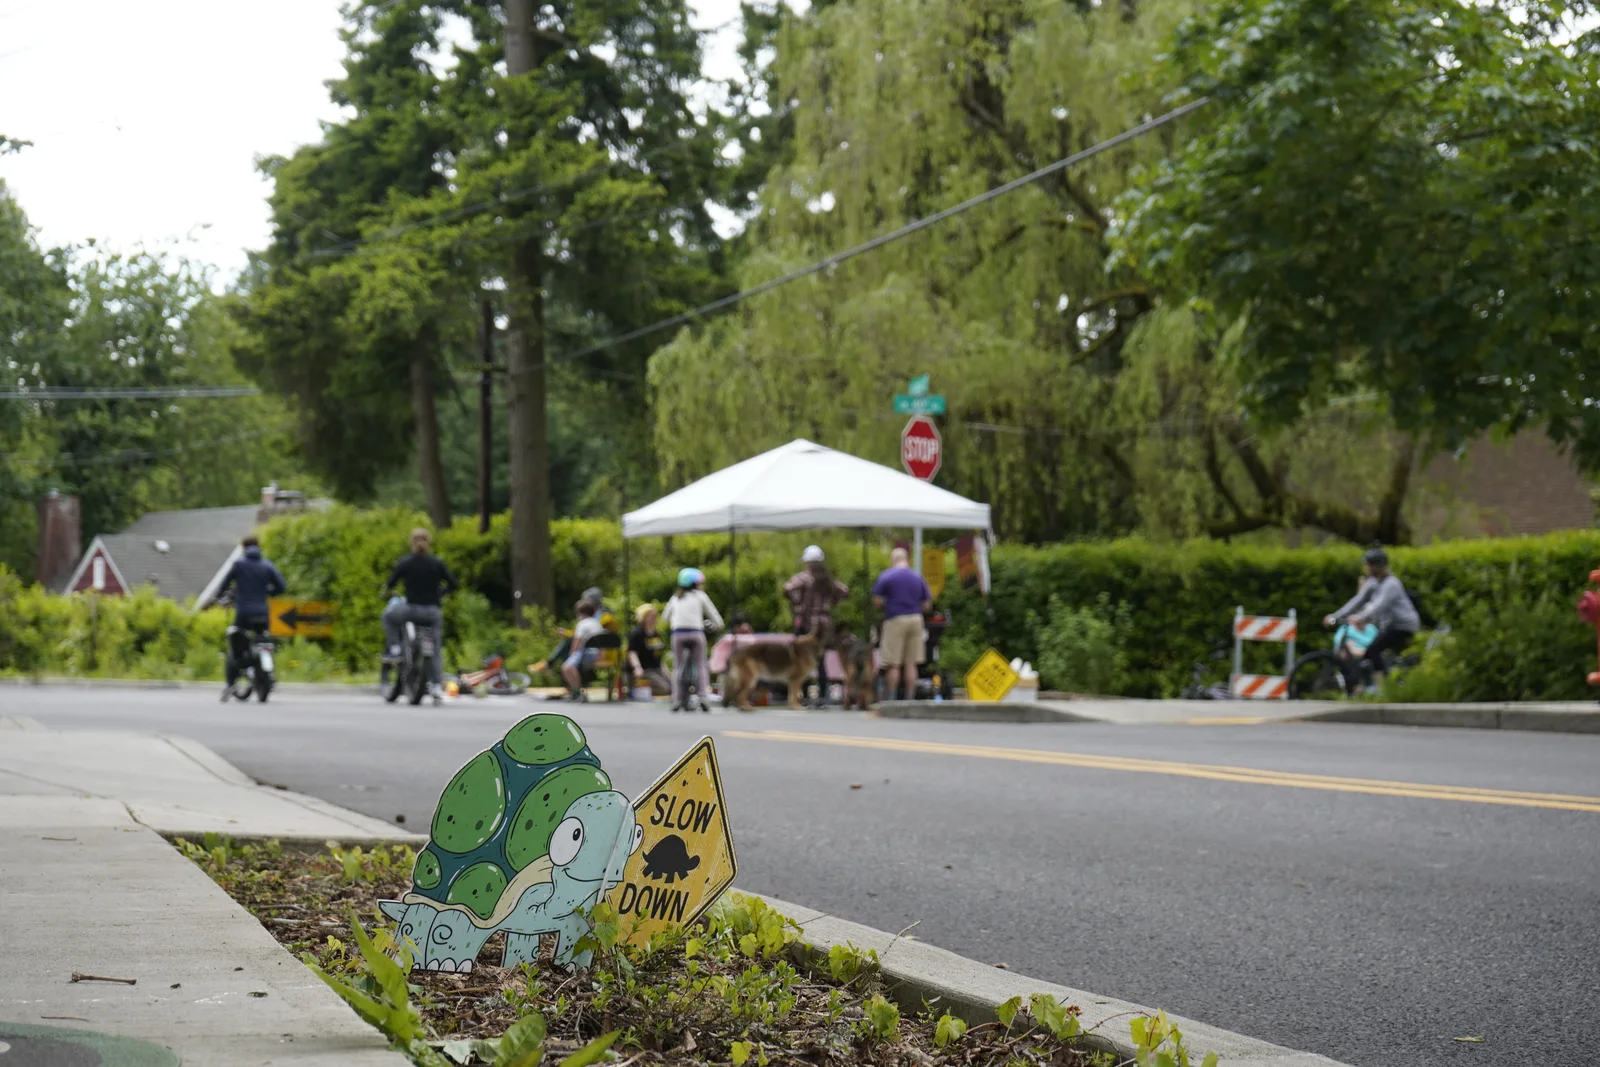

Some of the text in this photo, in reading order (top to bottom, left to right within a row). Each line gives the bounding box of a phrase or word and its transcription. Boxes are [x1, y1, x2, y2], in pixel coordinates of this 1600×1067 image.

[905, 436, 939, 463] STOP
[650, 793, 717, 834] SLOW
[618, 883, 689, 922] DOWN
